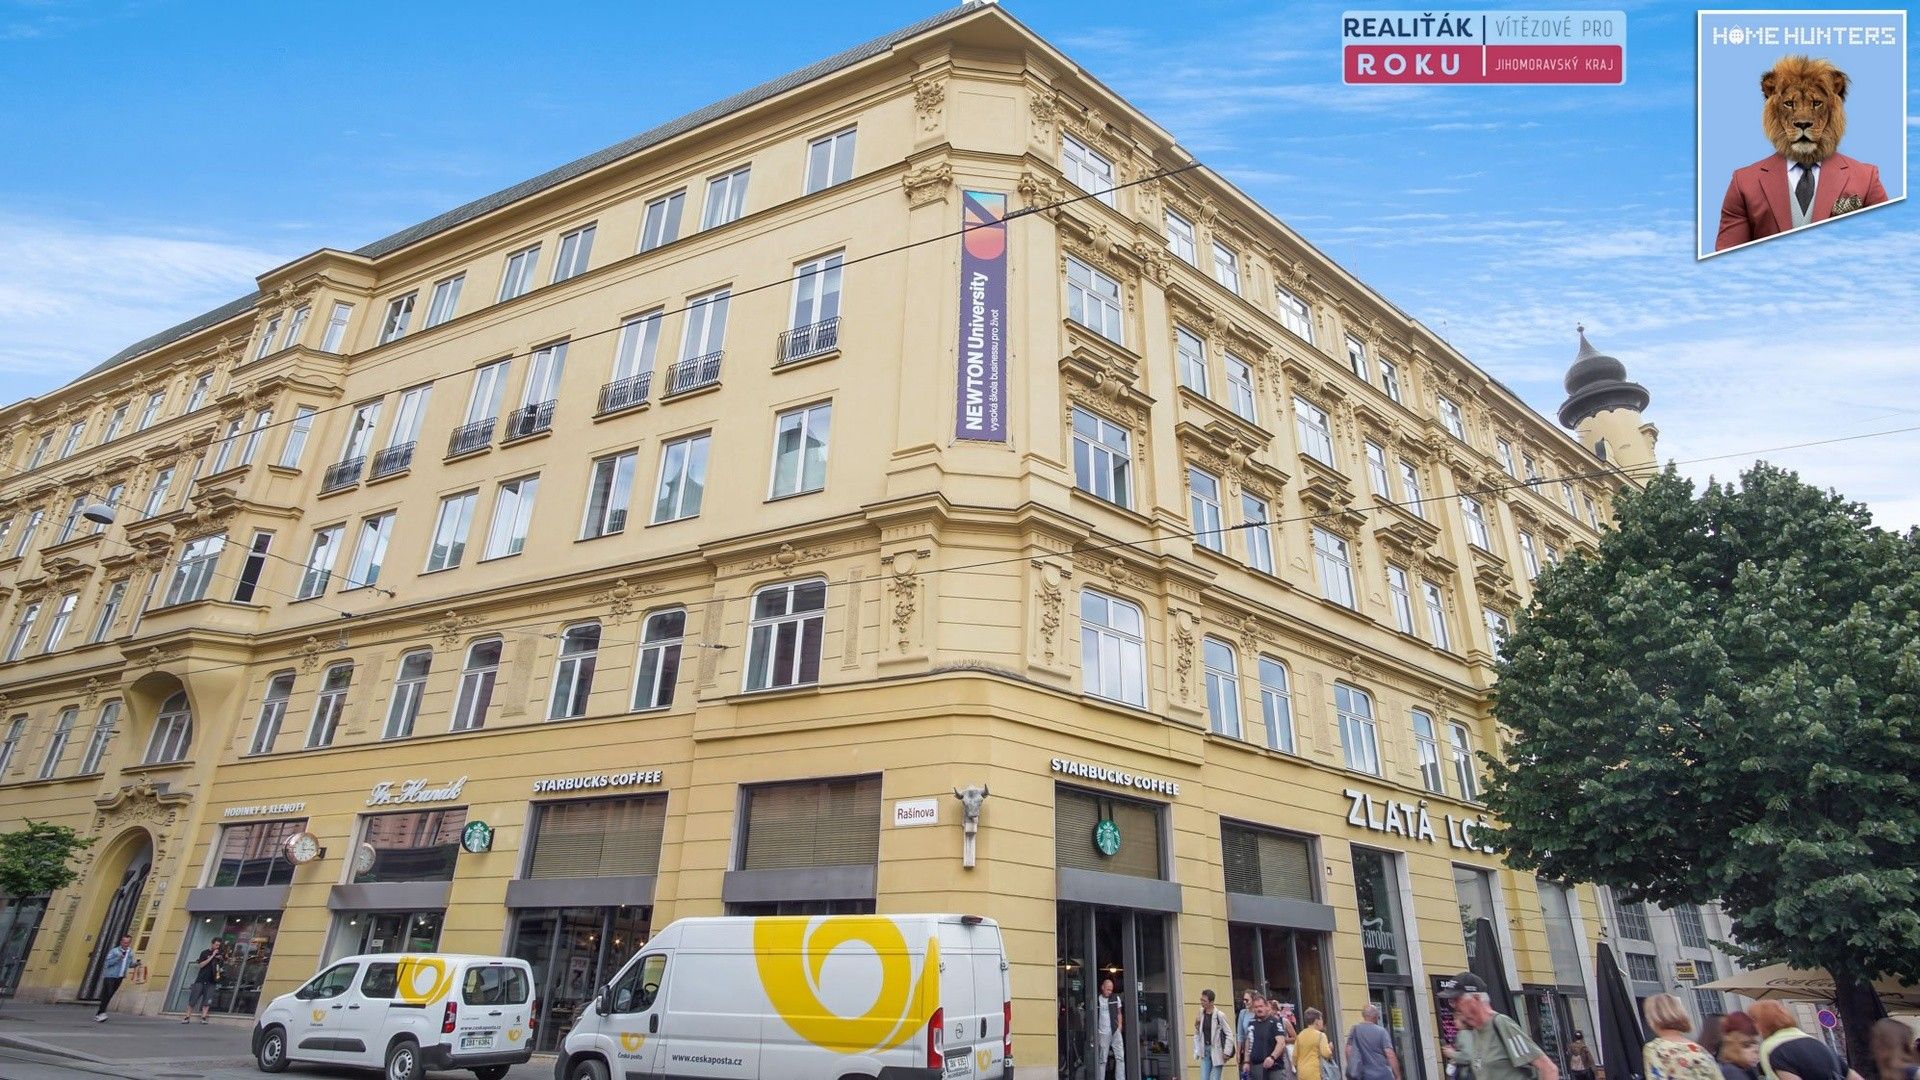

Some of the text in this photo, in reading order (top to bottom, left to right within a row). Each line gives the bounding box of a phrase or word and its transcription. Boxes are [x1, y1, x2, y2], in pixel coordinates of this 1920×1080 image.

[966, 271, 989, 430] NEWTON University
[989, 309, 1000, 432] vysoká škola businessu pro život
[532, 771, 662, 792] STARBUCKS COFFEE
[1051, 758, 1180, 796] STARBUCKS COFFEE
[224, 806, 260, 817] HODINKY
[269, 802, 305, 814] KLENOTY
[897, 807, 935, 820] Rašínova
[1344, 788, 1437, 843] ZLATÁ
[671, 1053, 743, 1066] www.ceskaposta.cz
